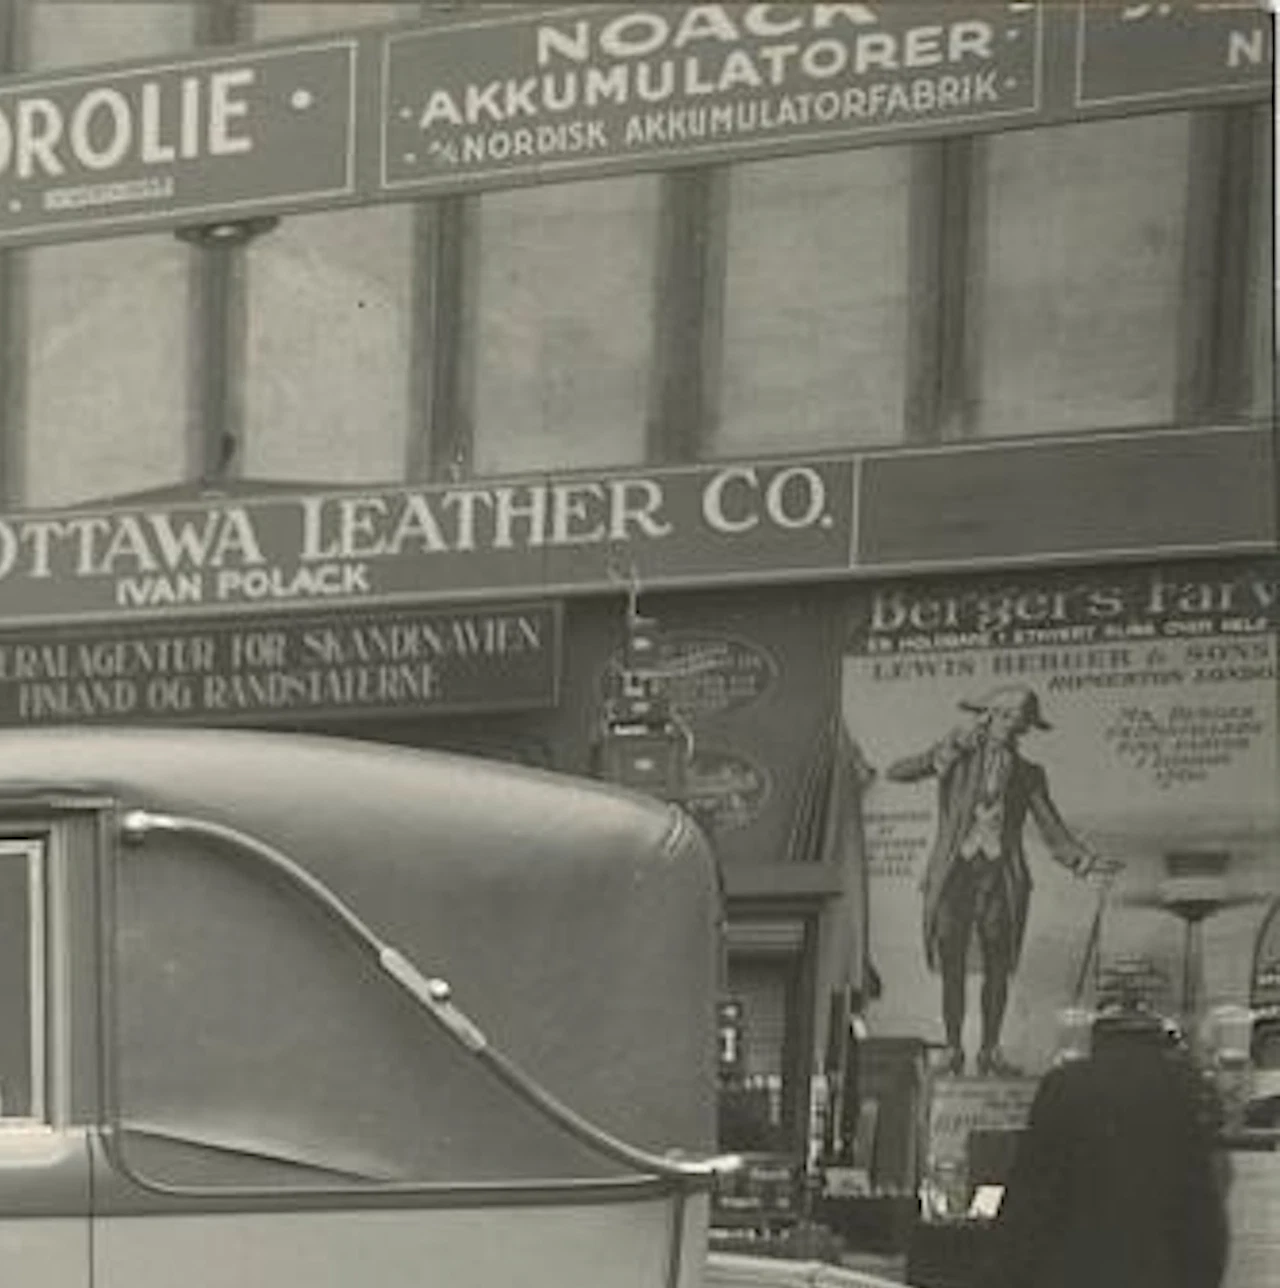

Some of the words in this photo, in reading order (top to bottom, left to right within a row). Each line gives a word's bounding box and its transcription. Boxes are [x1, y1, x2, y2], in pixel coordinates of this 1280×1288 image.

[419, 21, 994, 128] AKKUMULATORER
[462, 118, 607, 163] NORDISK
[625, 70, 999, 147] AKKUMULATORFABRIK
[300, 479, 673, 561] LEATHER
[702, 466, 834, 534] CO.
[116, 574, 202, 605] IVAN
[217, 564, 370, 600] POLACK
